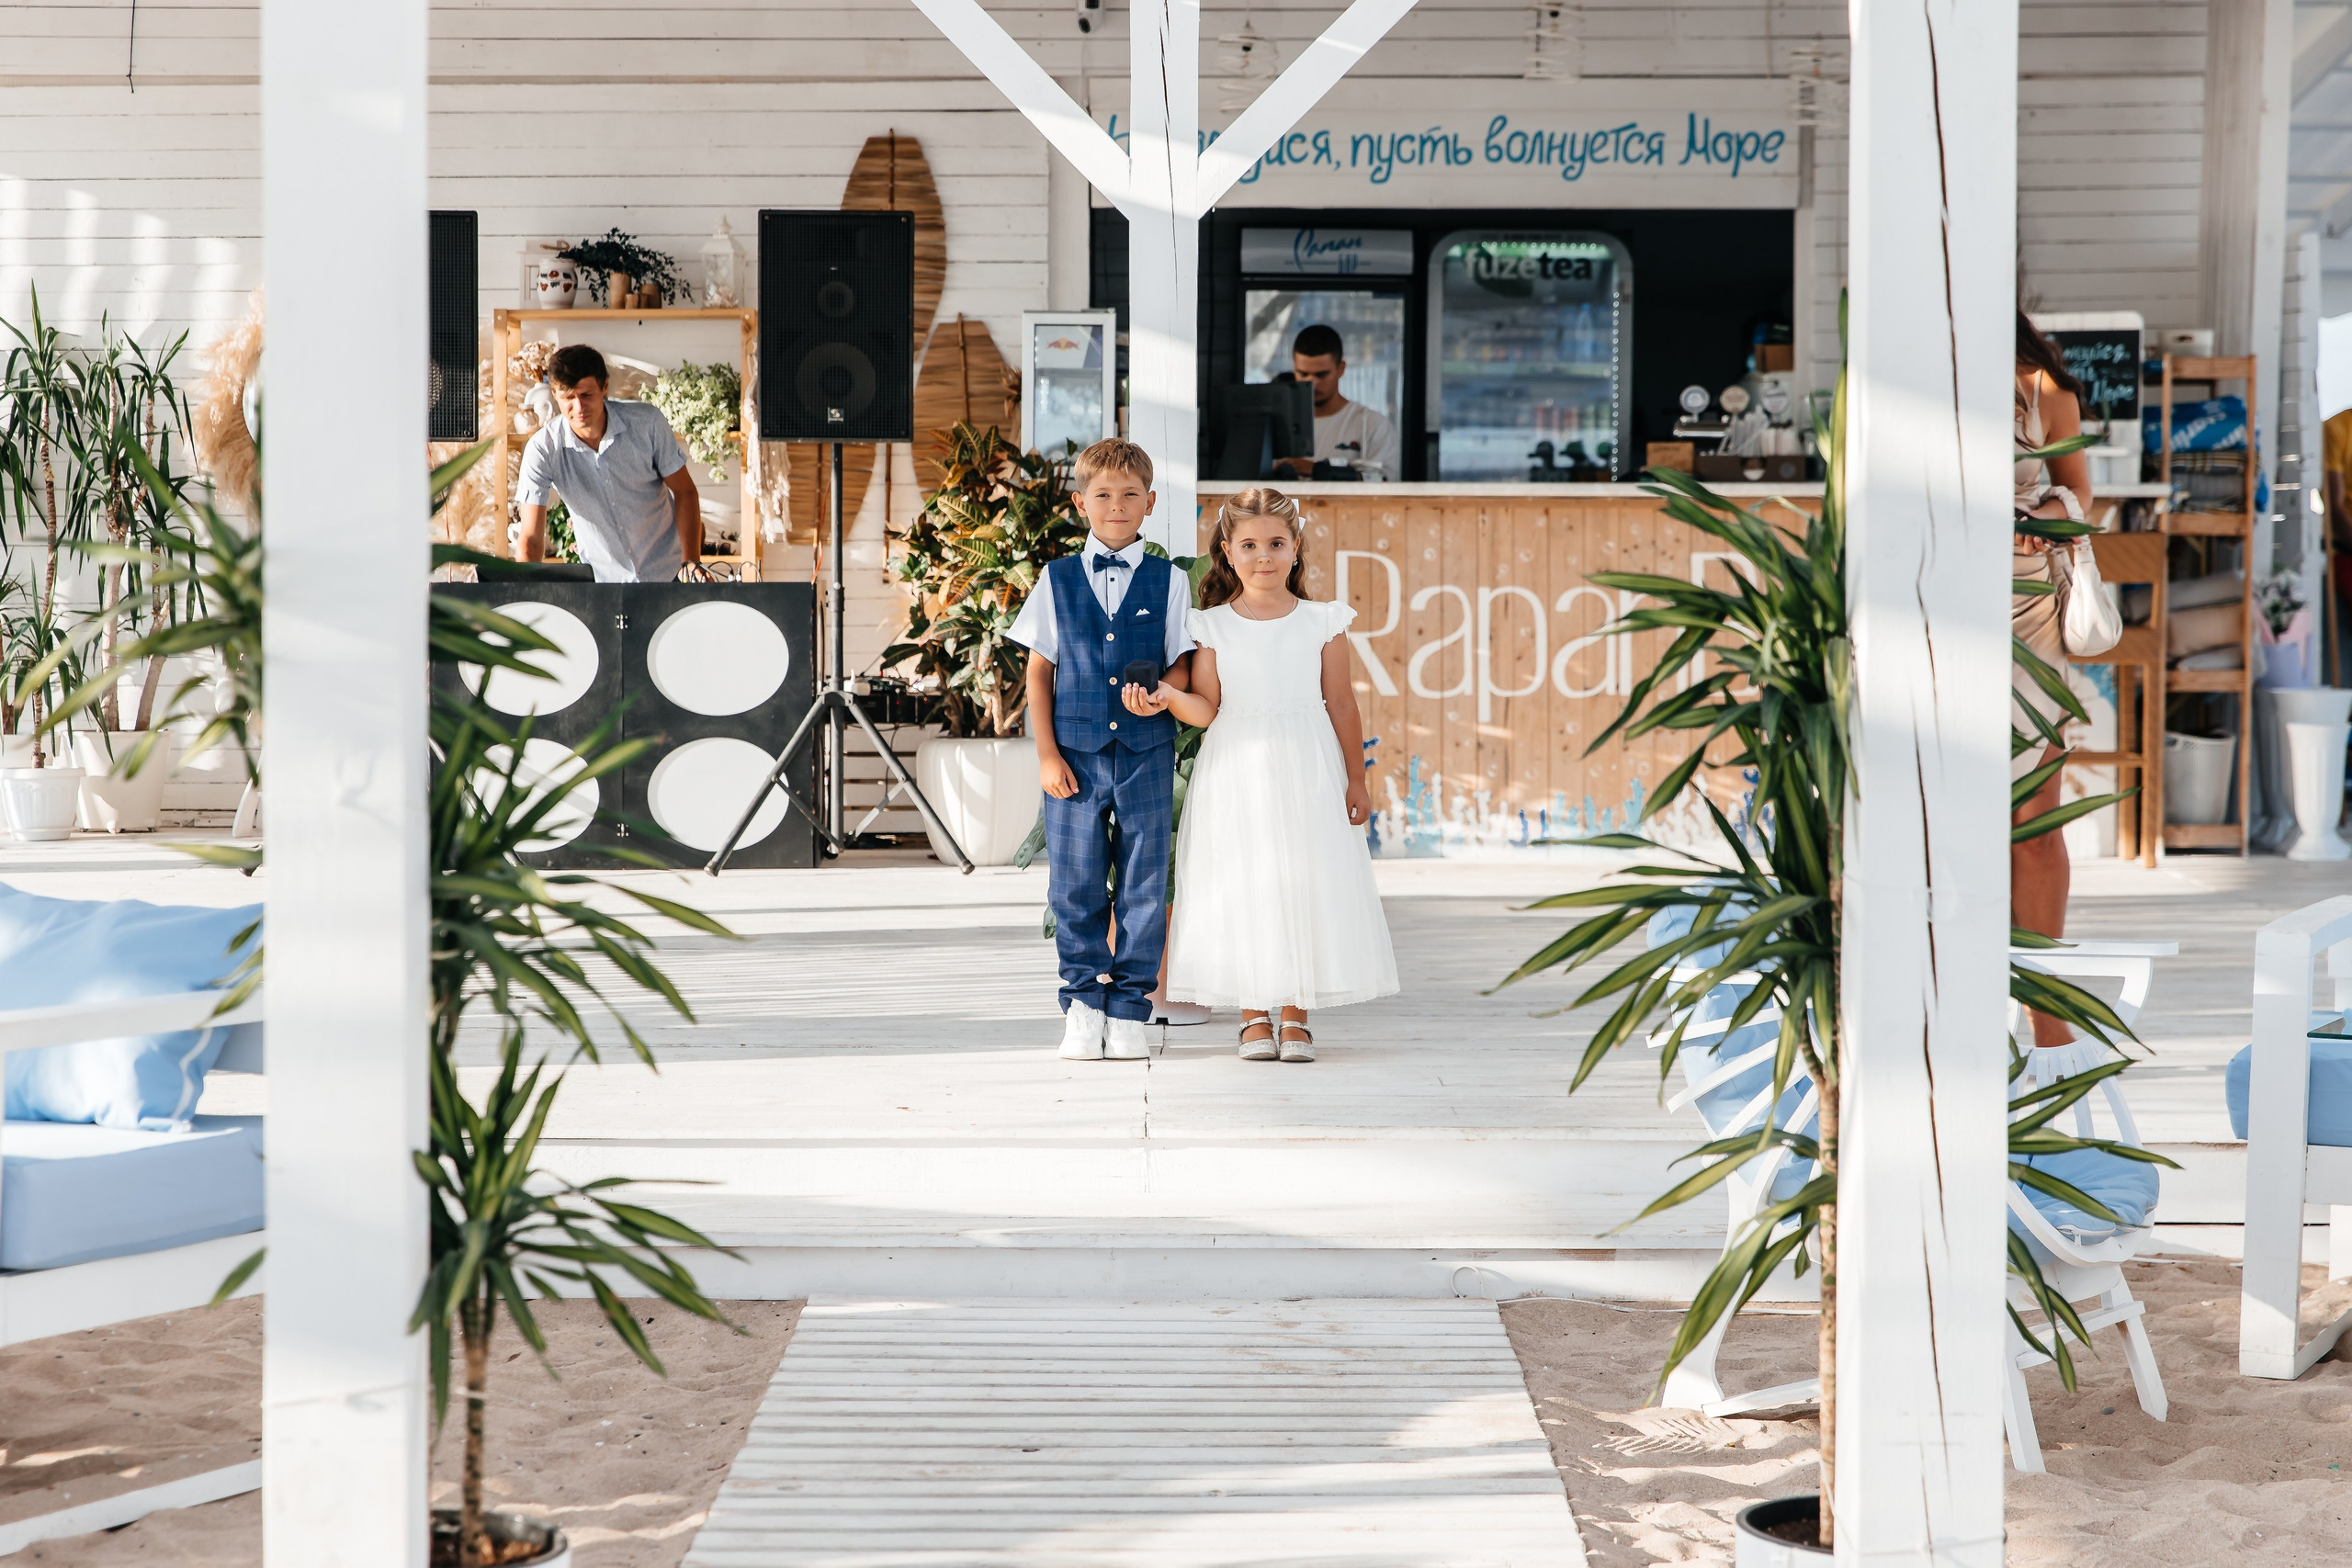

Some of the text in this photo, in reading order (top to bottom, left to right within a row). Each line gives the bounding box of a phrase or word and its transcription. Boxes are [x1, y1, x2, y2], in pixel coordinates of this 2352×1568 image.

[1351, 126, 1473, 184] пусть
[1484, 115, 1666, 181] волнуется
[1679, 112, 1785, 177] Море
